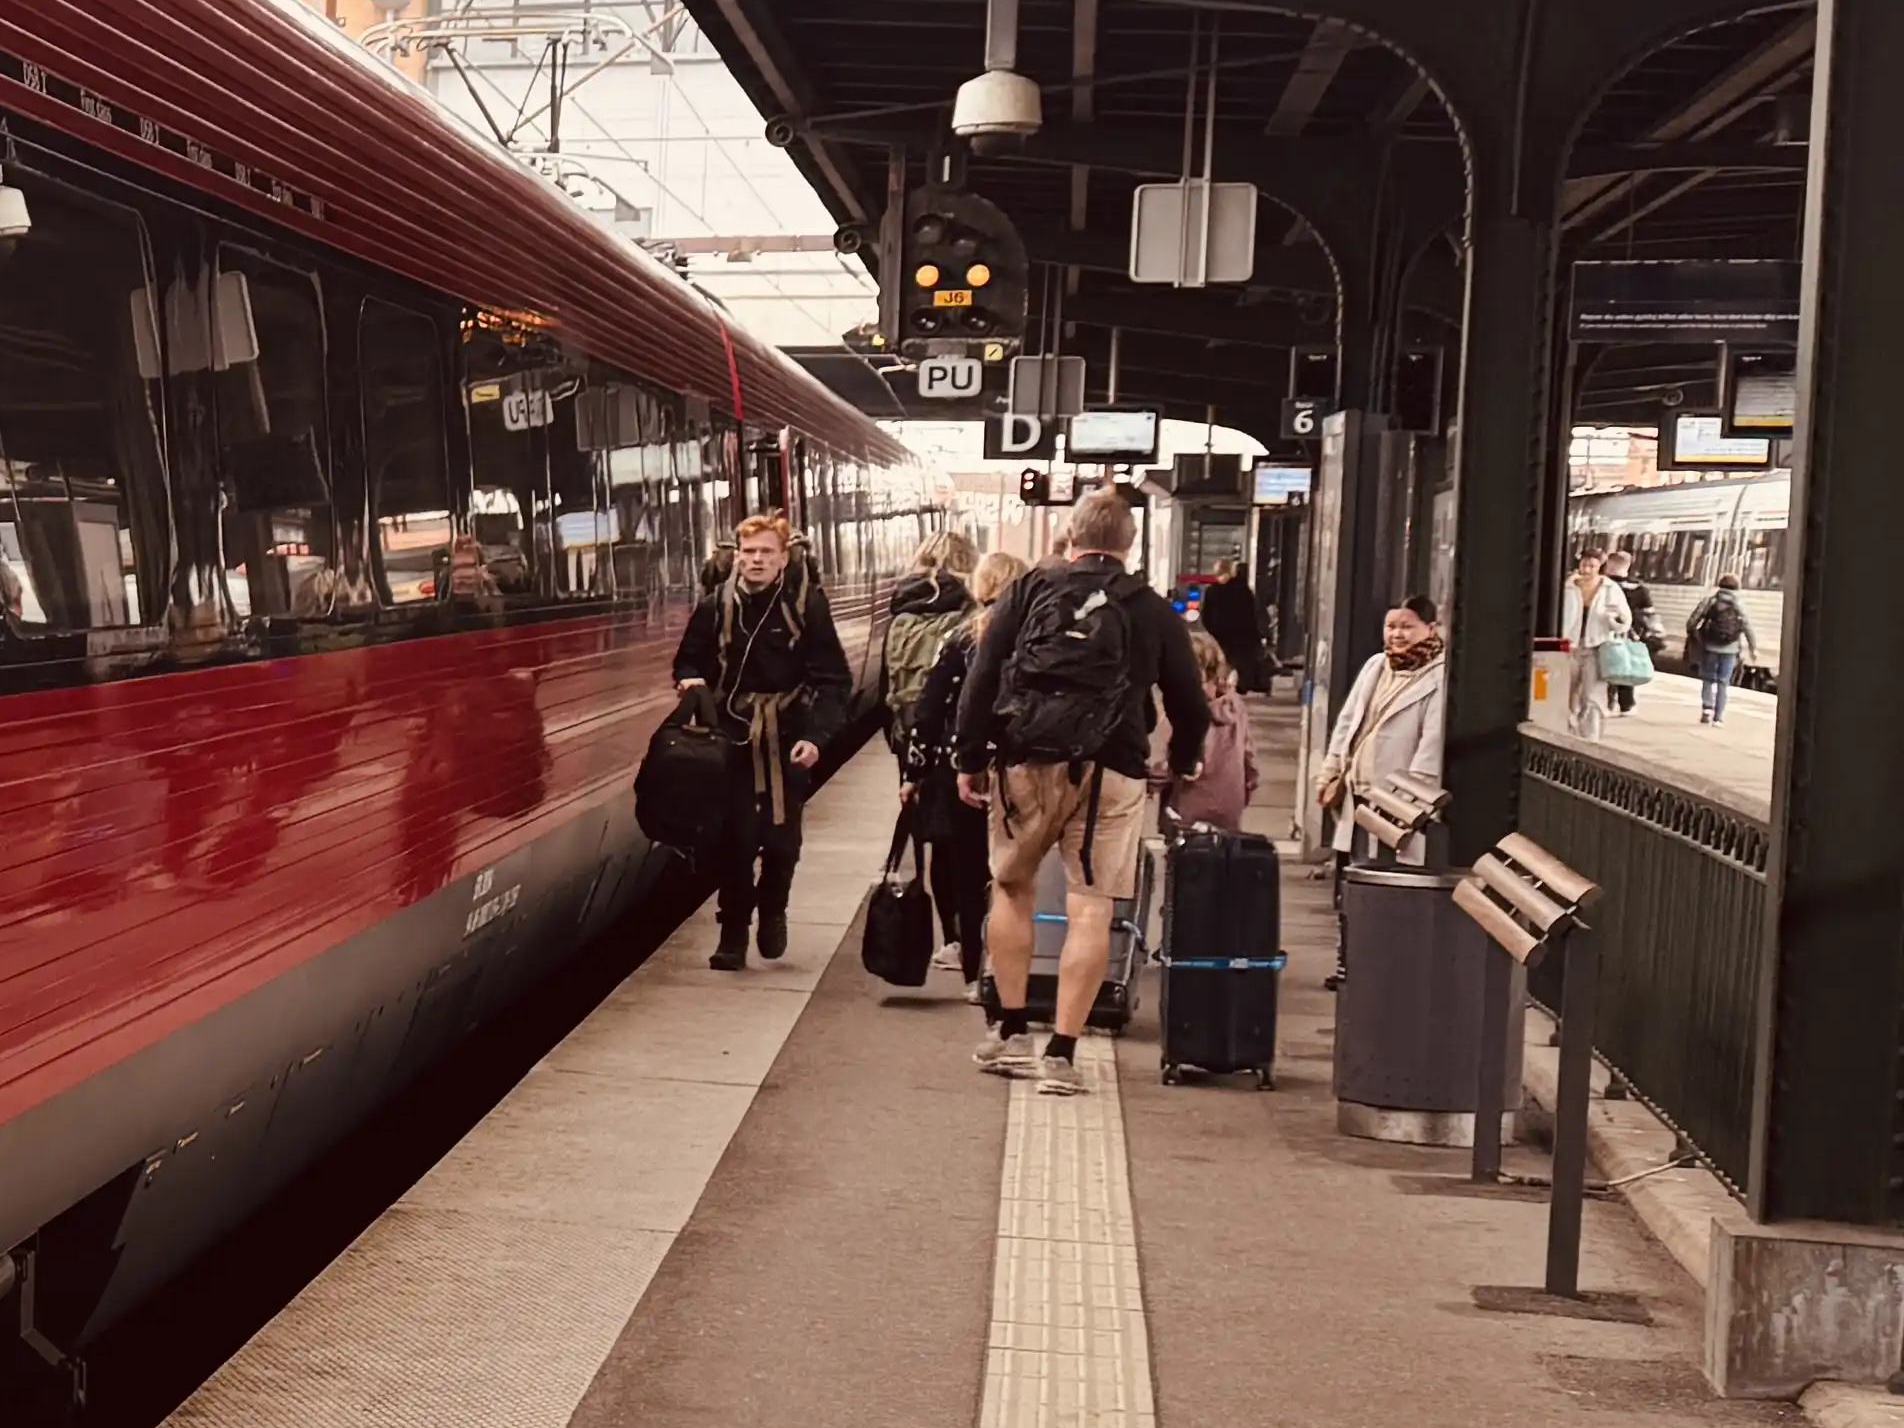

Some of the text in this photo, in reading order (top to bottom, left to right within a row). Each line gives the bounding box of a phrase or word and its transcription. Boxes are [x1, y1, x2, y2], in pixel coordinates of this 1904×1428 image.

[928, 365, 974, 390] PU
[1002, 413, 1042, 453] D
[1293, 410, 1314, 434] 6
